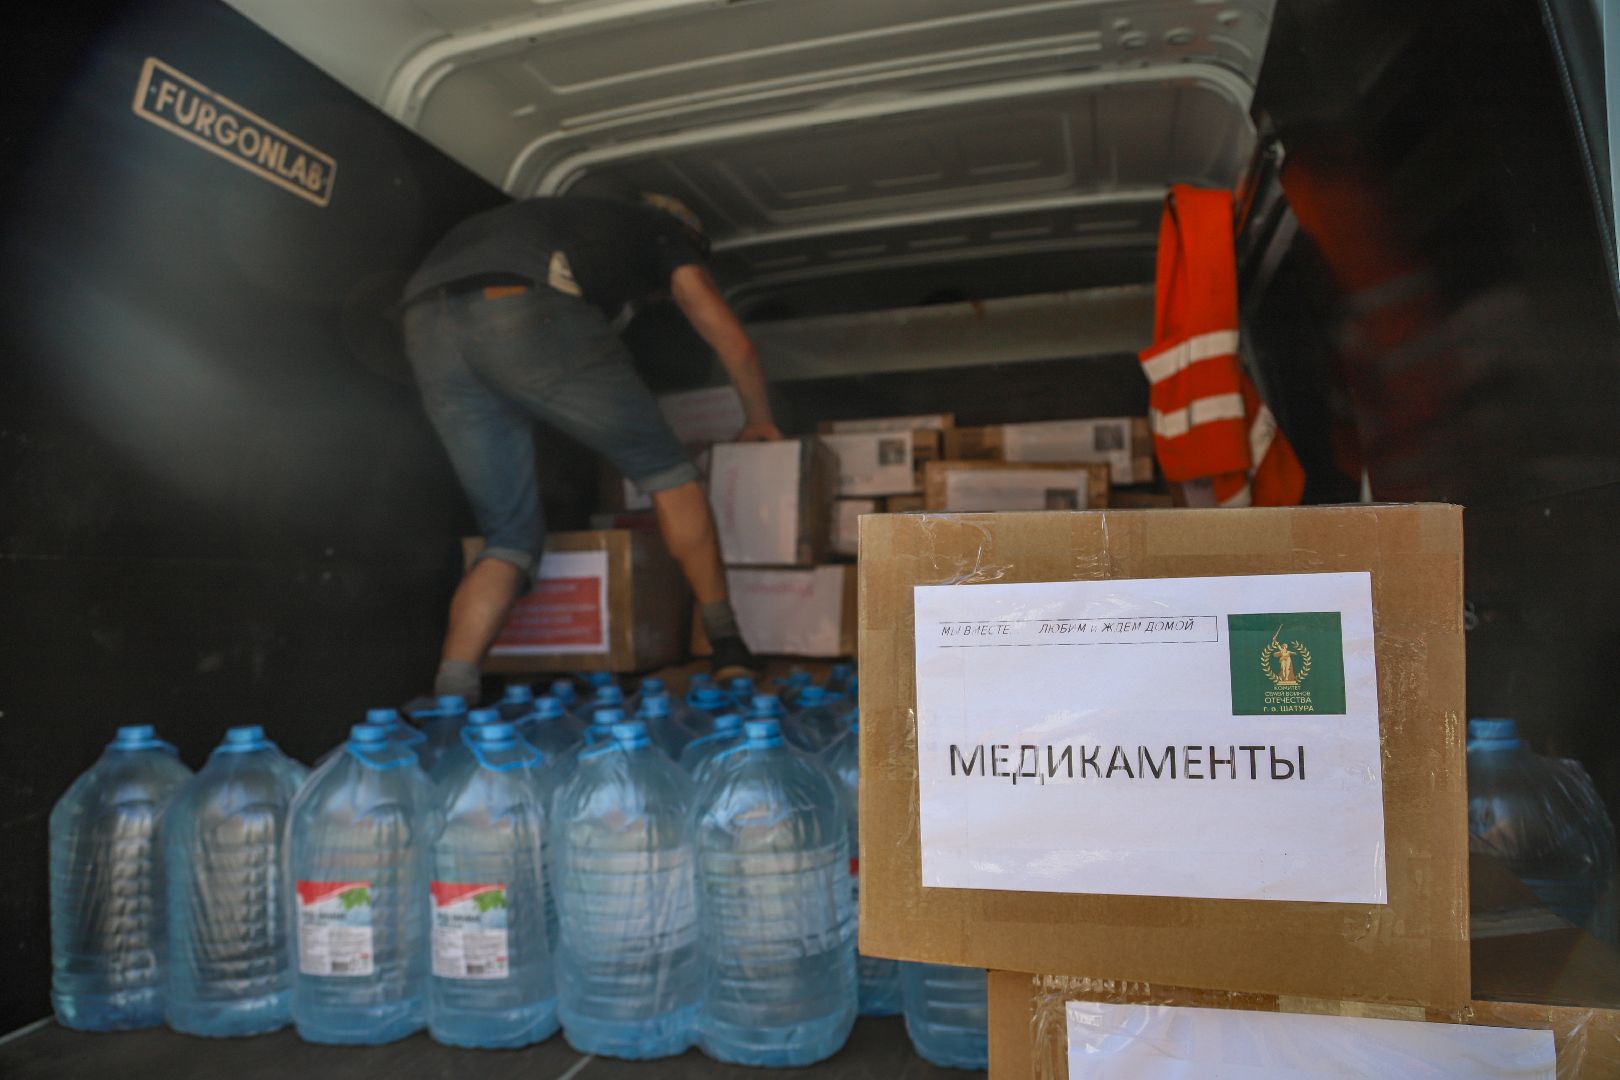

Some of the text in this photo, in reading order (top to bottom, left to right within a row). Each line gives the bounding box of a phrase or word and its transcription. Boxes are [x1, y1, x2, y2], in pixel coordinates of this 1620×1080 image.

[155, 80, 324, 191] FURGONLAB
[1039, 623, 1087, 634] ЛЮБИМ
[1101, 622, 1142, 633] ЖДЕМ
[1144, 618, 1195, 632] ДОМОЙ
[950, 744, 1305, 785] МЕДИКАМЕНТЫ
